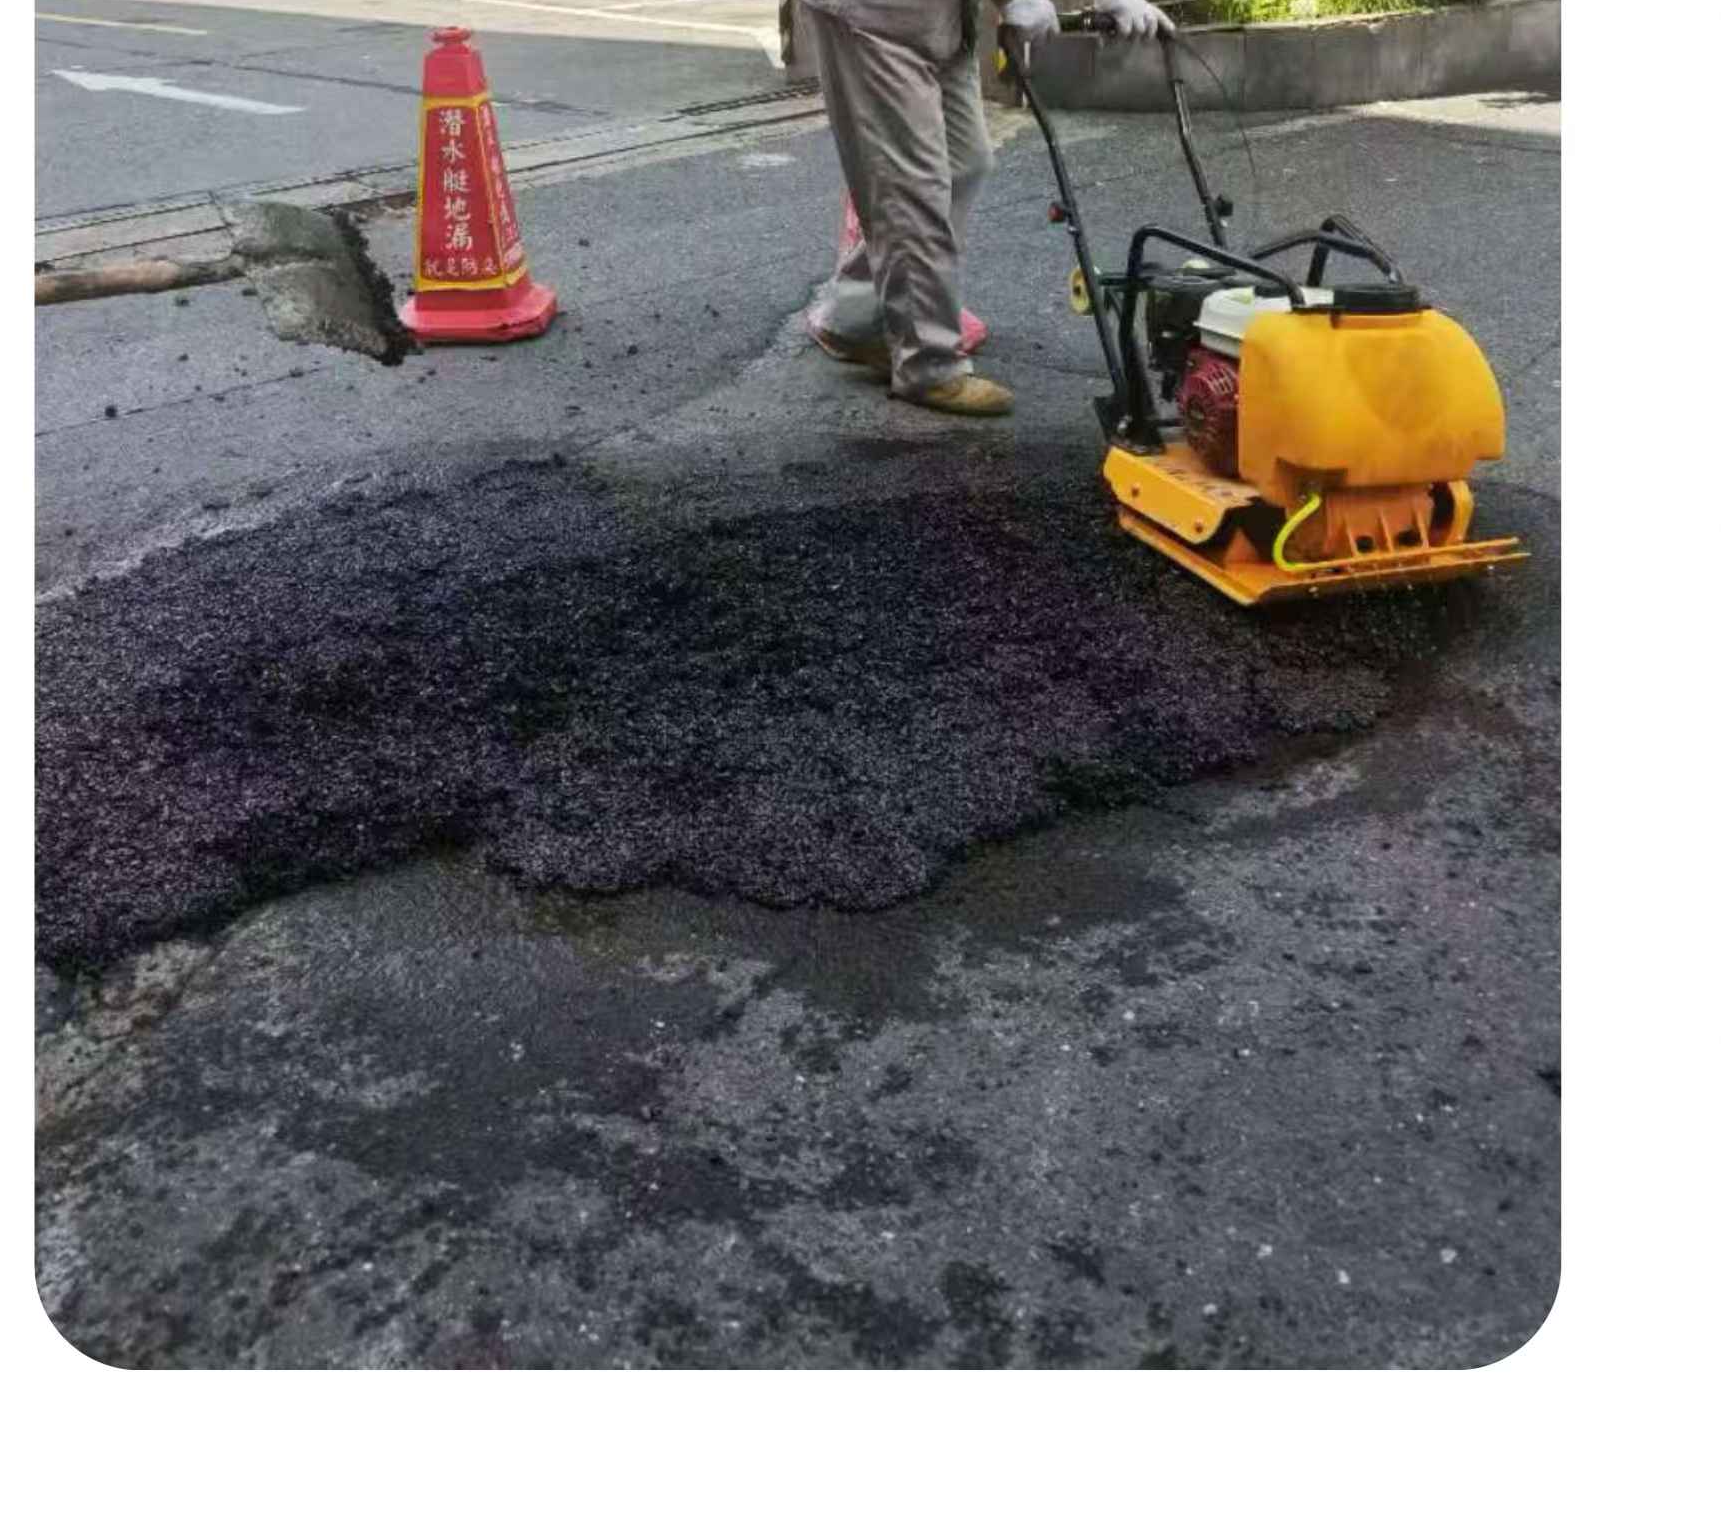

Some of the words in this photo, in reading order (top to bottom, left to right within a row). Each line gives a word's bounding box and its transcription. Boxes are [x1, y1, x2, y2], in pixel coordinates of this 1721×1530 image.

[438, 108, 474, 251] 潜水艇地漏
